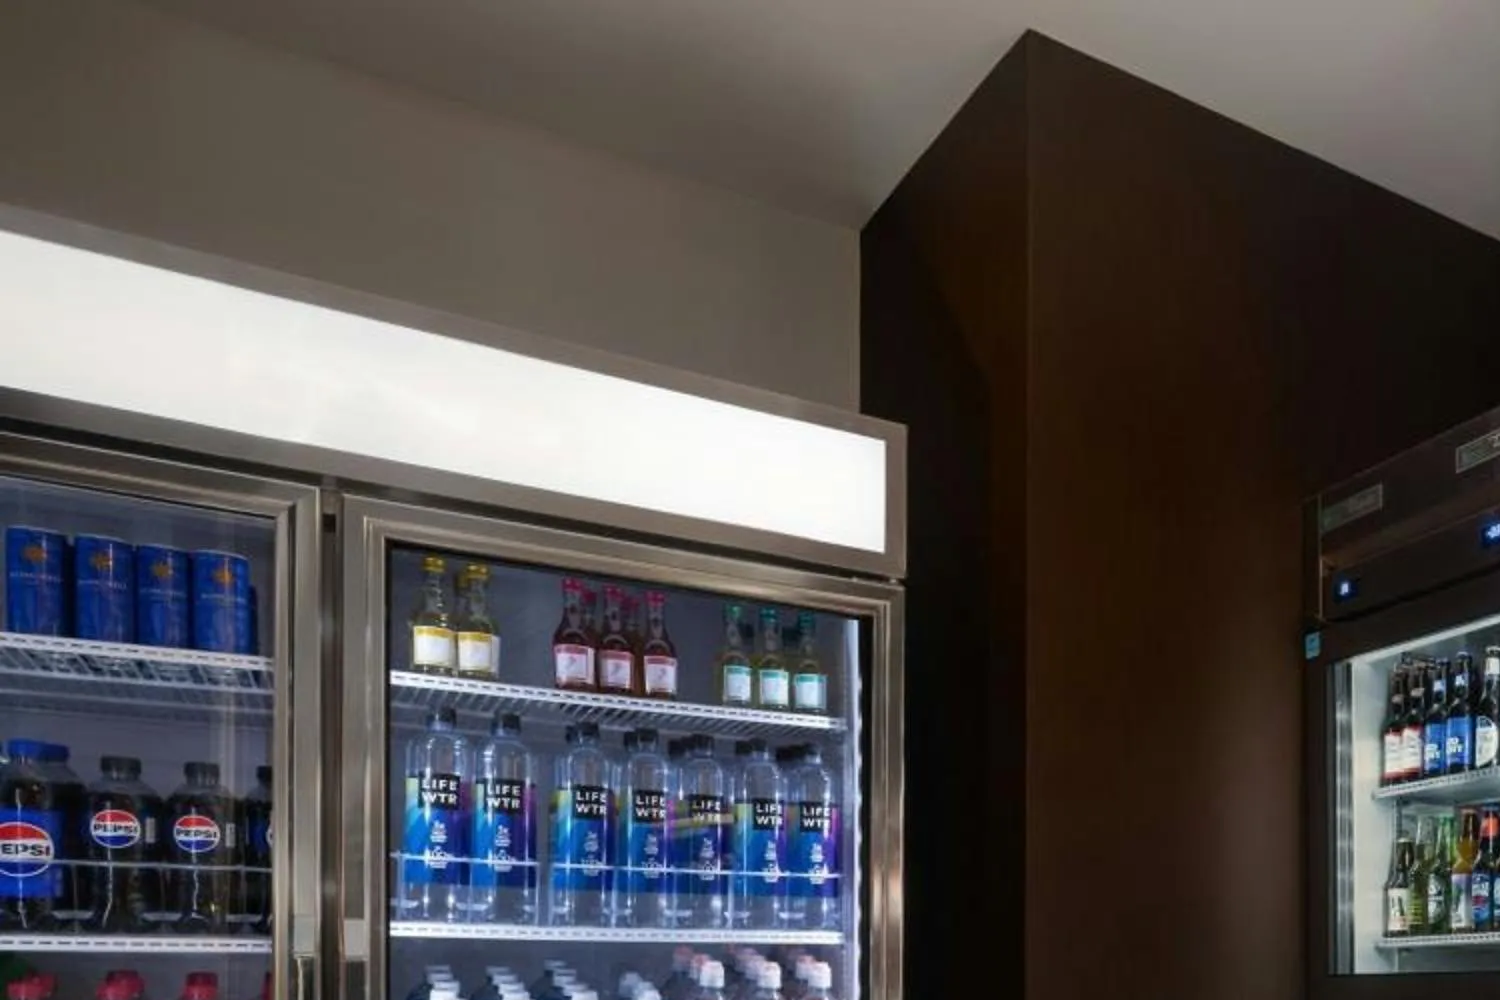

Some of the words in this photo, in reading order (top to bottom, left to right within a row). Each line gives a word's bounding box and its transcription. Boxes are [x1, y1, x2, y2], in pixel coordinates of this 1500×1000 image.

[421, 778, 458, 791] LIFE
[487, 783, 521, 796] LIFE
[420, 793, 458, 806] WTR
[575, 790, 608, 802] LIFE
[635, 794, 665, 806] LIFE
[486, 797, 521, 810] WTR
[574, 803, 607, 816] WTR
[92, 823, 138, 834] PEPSI
[174, 828, 218, 840] PEPSI
[0, 842, 51, 858] EPSI
